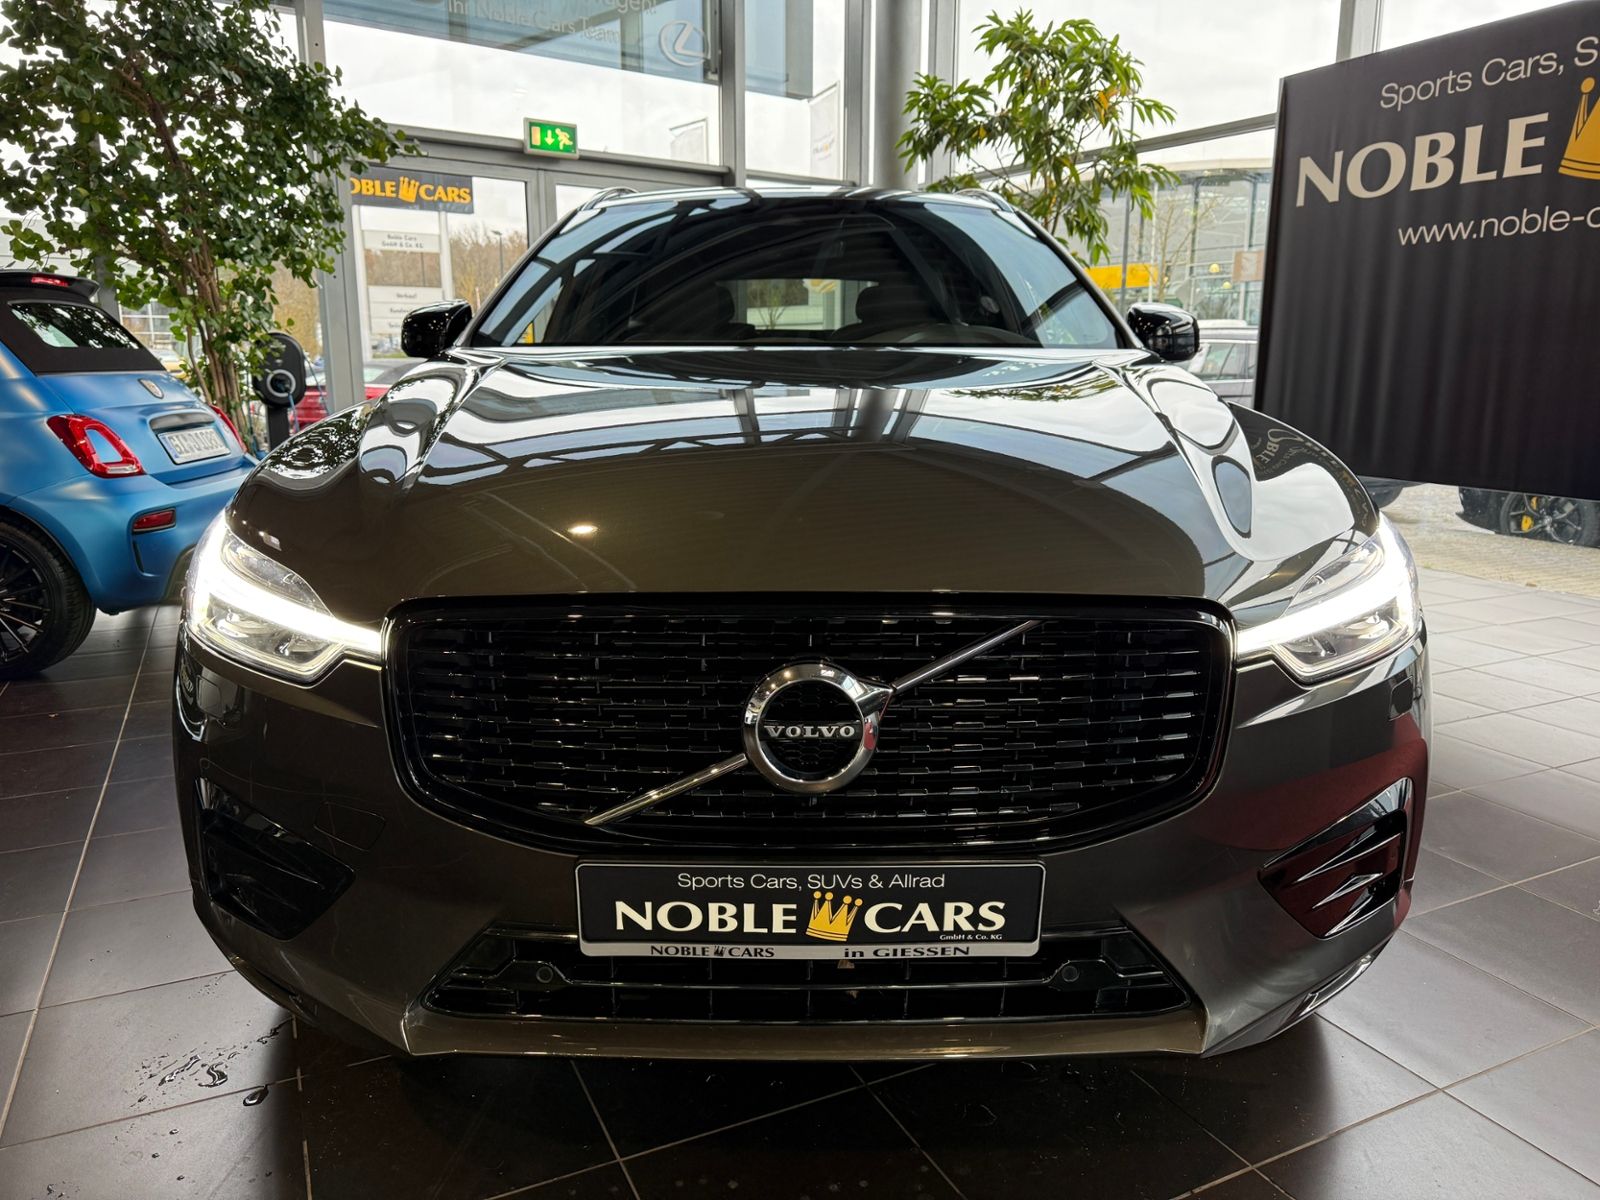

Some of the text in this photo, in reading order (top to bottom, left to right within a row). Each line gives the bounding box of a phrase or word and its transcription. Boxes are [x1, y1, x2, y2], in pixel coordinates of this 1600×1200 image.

[1379, 36, 1600, 111] Sports Cars, S
[1296, 112, 1549, 207] NOBLE
[350, 176, 471, 204] OBLE CARS
[764, 725, 855, 738] VOLVO
[678, 873, 945, 892] Sports Cars, SUVs & Allrad
[615, 900, 1006, 933] NOBLE CARS
[975, 933, 989, 941] Co.
[990, 933, 1003, 941] KG
[651, 945, 970, 958] NOBLE CARS in GIESSEN
